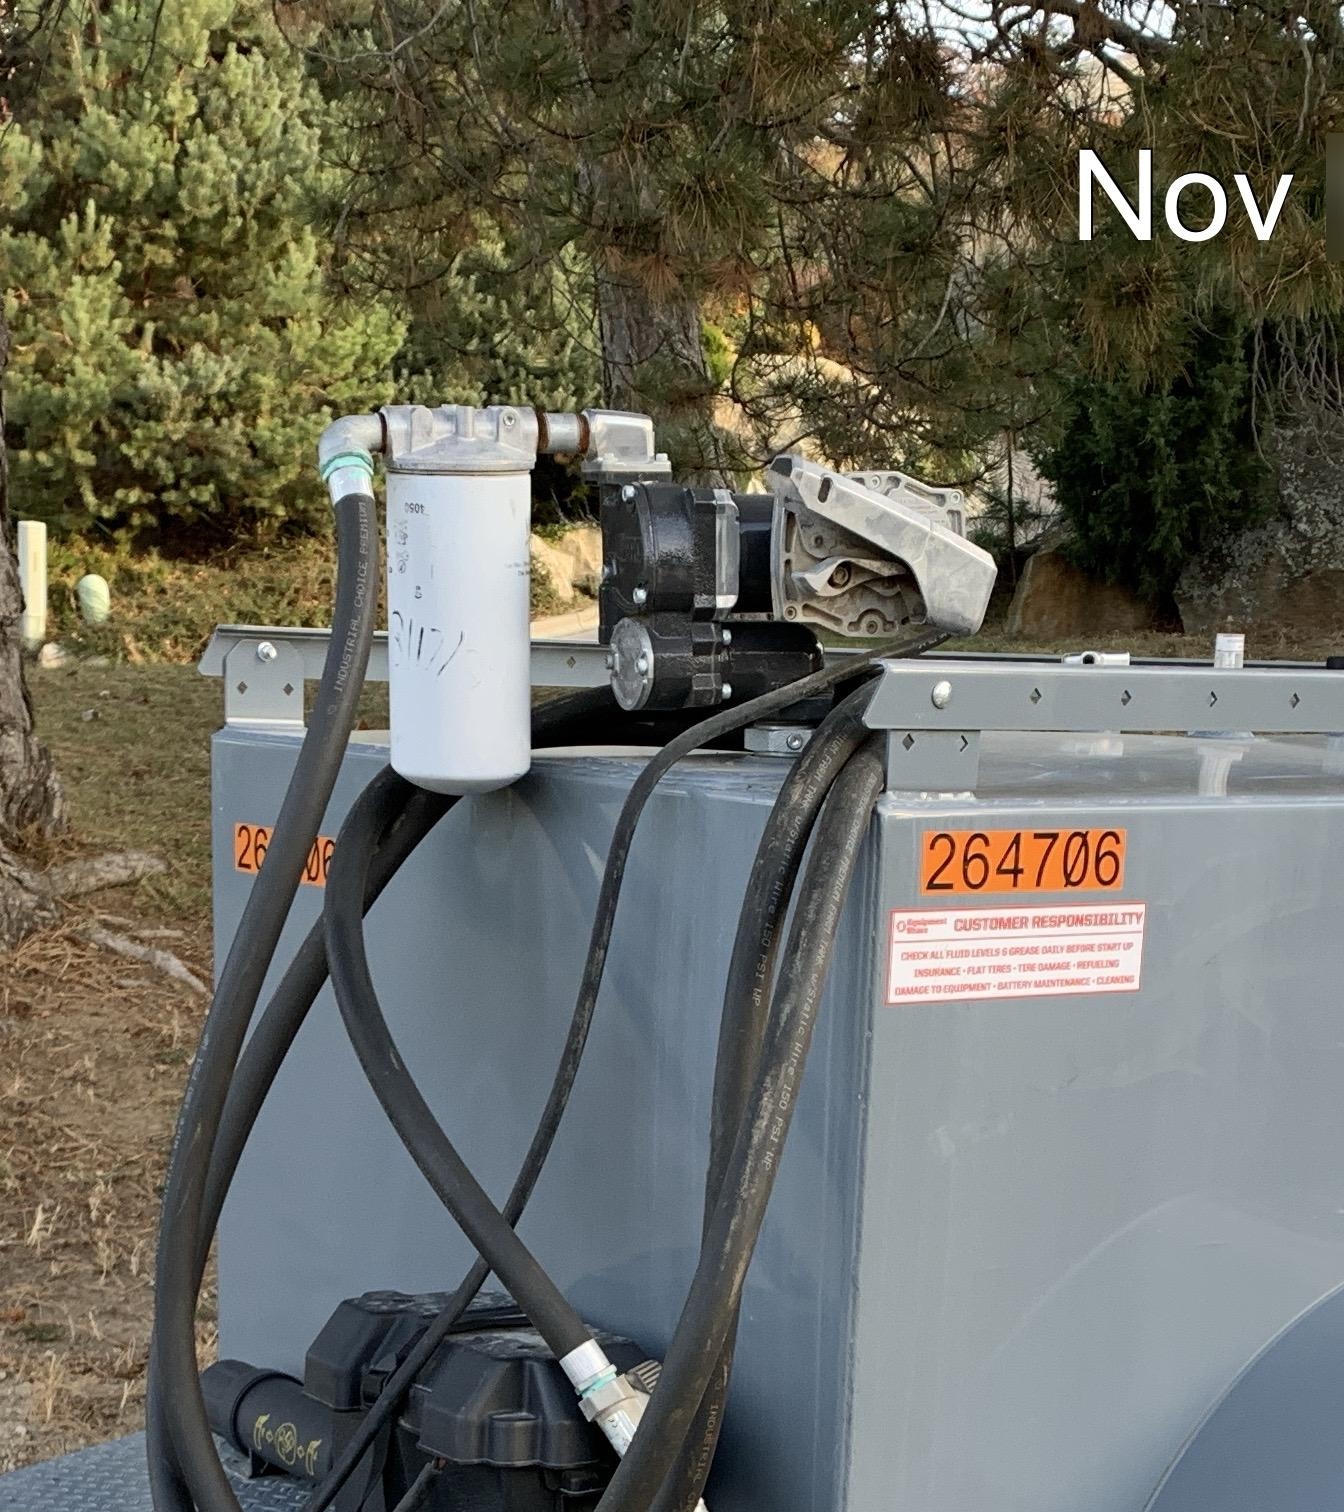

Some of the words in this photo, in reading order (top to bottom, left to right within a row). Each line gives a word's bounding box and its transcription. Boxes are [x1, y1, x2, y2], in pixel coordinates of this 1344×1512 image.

[334, 612, 361, 692] INDUSTRIAL
[354, 561, 369, 608] CHOICE
[801, 784, 817, 811] TANK
[237, 825, 336, 882] 2606
[925, 830, 1122, 890] 264706
[829, 856, 852, 902] PREMIUM
[766, 880, 783, 914] Wire
[822, 904, 840, 934] FARM
[954, 915, 1029, 932] CUSTOMER
[1031, 912, 1144, 929] RESPONSIBILITY
[761, 922, 775, 948] 150
[813, 939, 831, 968] TANK
[901, 951, 929, 961] CHECK
[929, 950, 944, 960] ALL
[946, 949, 970, 959] FLUID
[971, 948, 1000, 958] LEVELS
[1009, 946, 1040, 957] GREASE
[1042, 945, 1065, 955] DAILY
[1066, 943, 1096, 954] BEFORE
[1097, 942, 1121, 952] START
[1123, 942, 1133, 950] UP
[754, 953, 769, 981] PSI
[914, 967, 961, 978] INSURANCE
[967, 966, 986, 975] FLAT
[988, 965, 1011, 974] TIRES
[1018, 963, 1037, 972] TIRE
[1038, 961, 1071, 971] DAMAGE
[1077, 959, 1119, 969] REFUELING
[751, 988, 763, 1007] WP
[895, 986, 929, 996] DAMAGE
[931, 985, 942, 994] TO
[943, 983, 991, 994] EQUIPMENT
[997, 980, 1032, 990] BATTERY
[1034, 977, 1091, 988] MAINTENANCE
[1096, 975, 1135, 985] CLEANING
[797, 973, 821, 1035] w/Static
[785, 1041, 804, 1076] Wire
[777, 1082, 793, 1110] 150
[768, 1115, 785, 1143] PSI
[762, 1151, 775, 1172] WP
